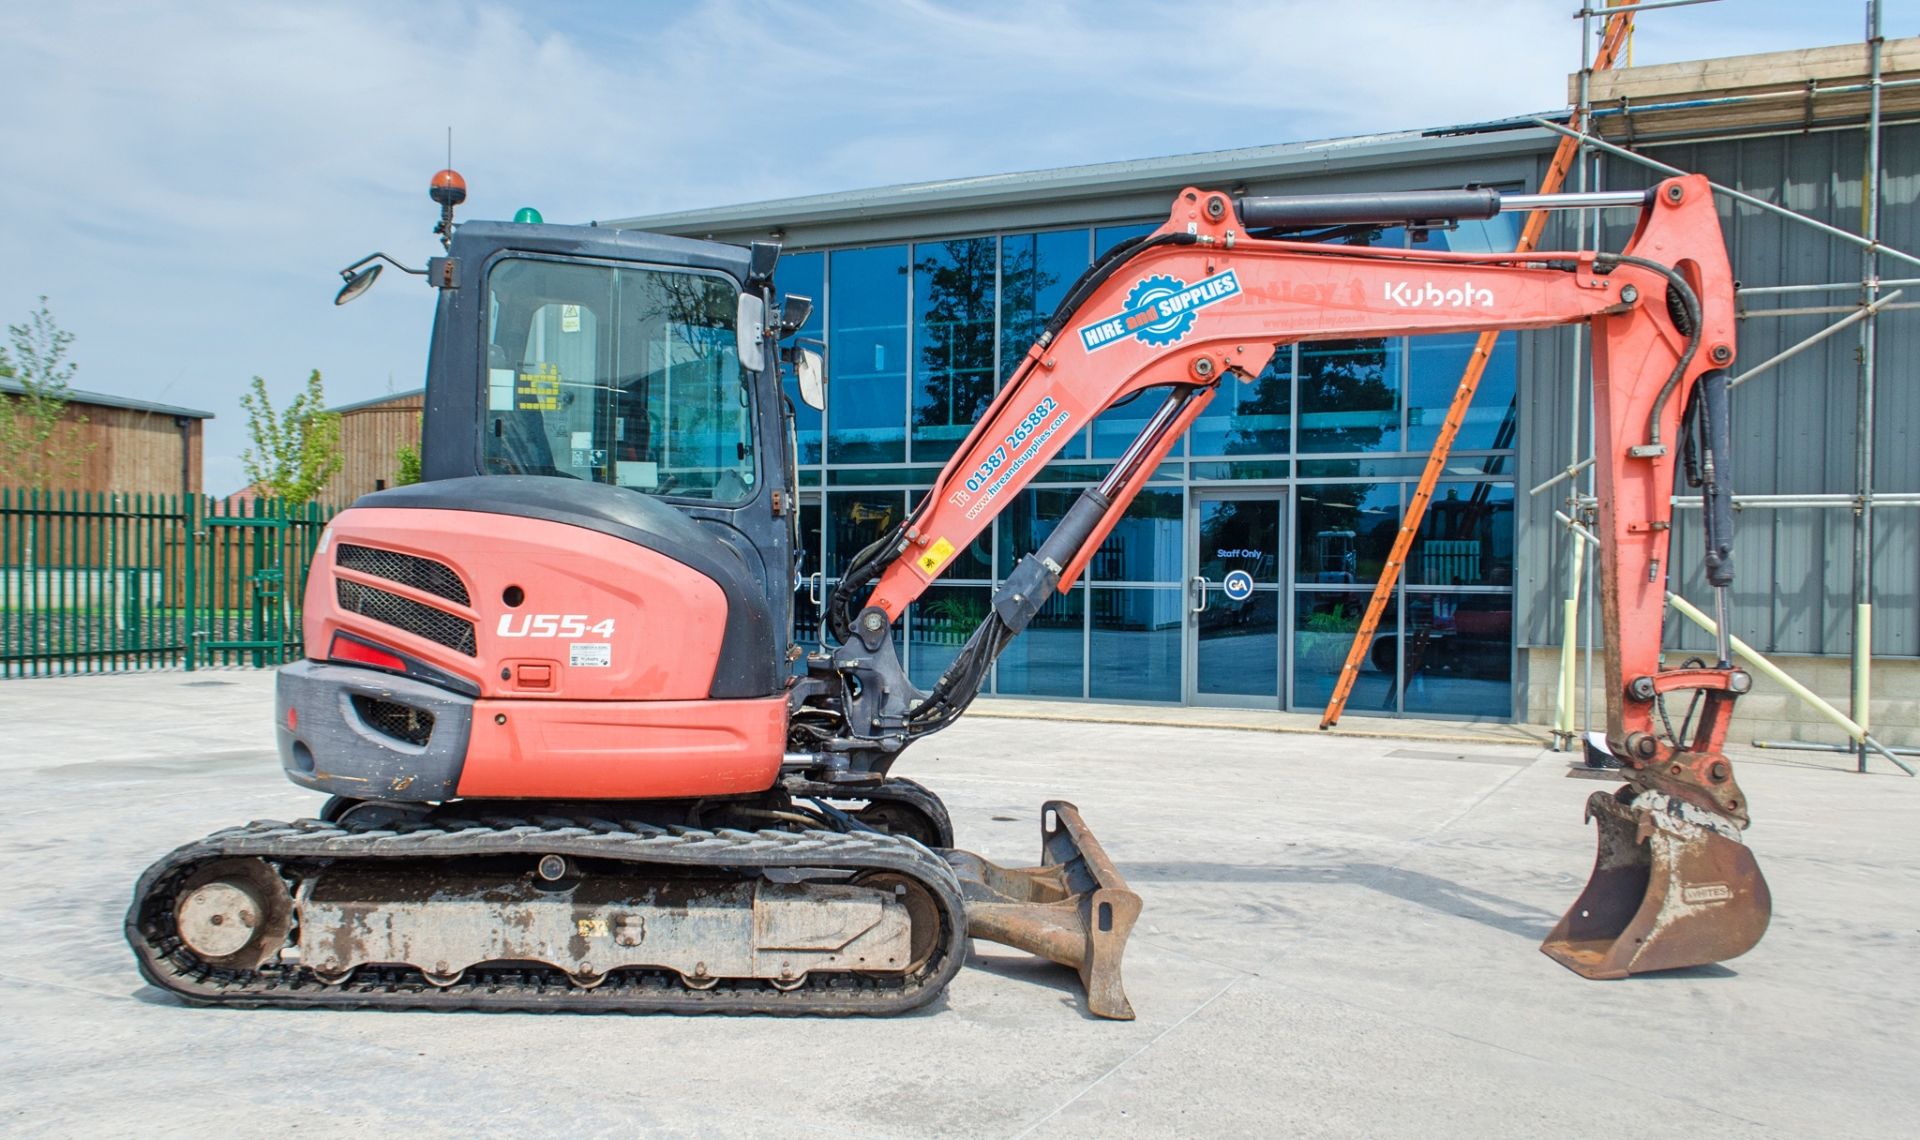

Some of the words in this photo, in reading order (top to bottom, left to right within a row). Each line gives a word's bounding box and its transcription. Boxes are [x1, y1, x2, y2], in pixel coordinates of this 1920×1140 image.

[1084, 319, 1125, 347] HIRE
[1126, 307, 1159, 330] and
[1158, 274, 1236, 317] SUPPLIES
[1384, 281, 1494, 307] Kubota
[950, 491, 970, 507] T:
[965, 446, 1007, 493] 01387
[1006, 397, 1058, 450] 265882
[966, 411, 1070, 520] www.hireandsupplies.com
[1217, 549, 1240, 558] Staff
[1241, 549, 1262, 560] Only
